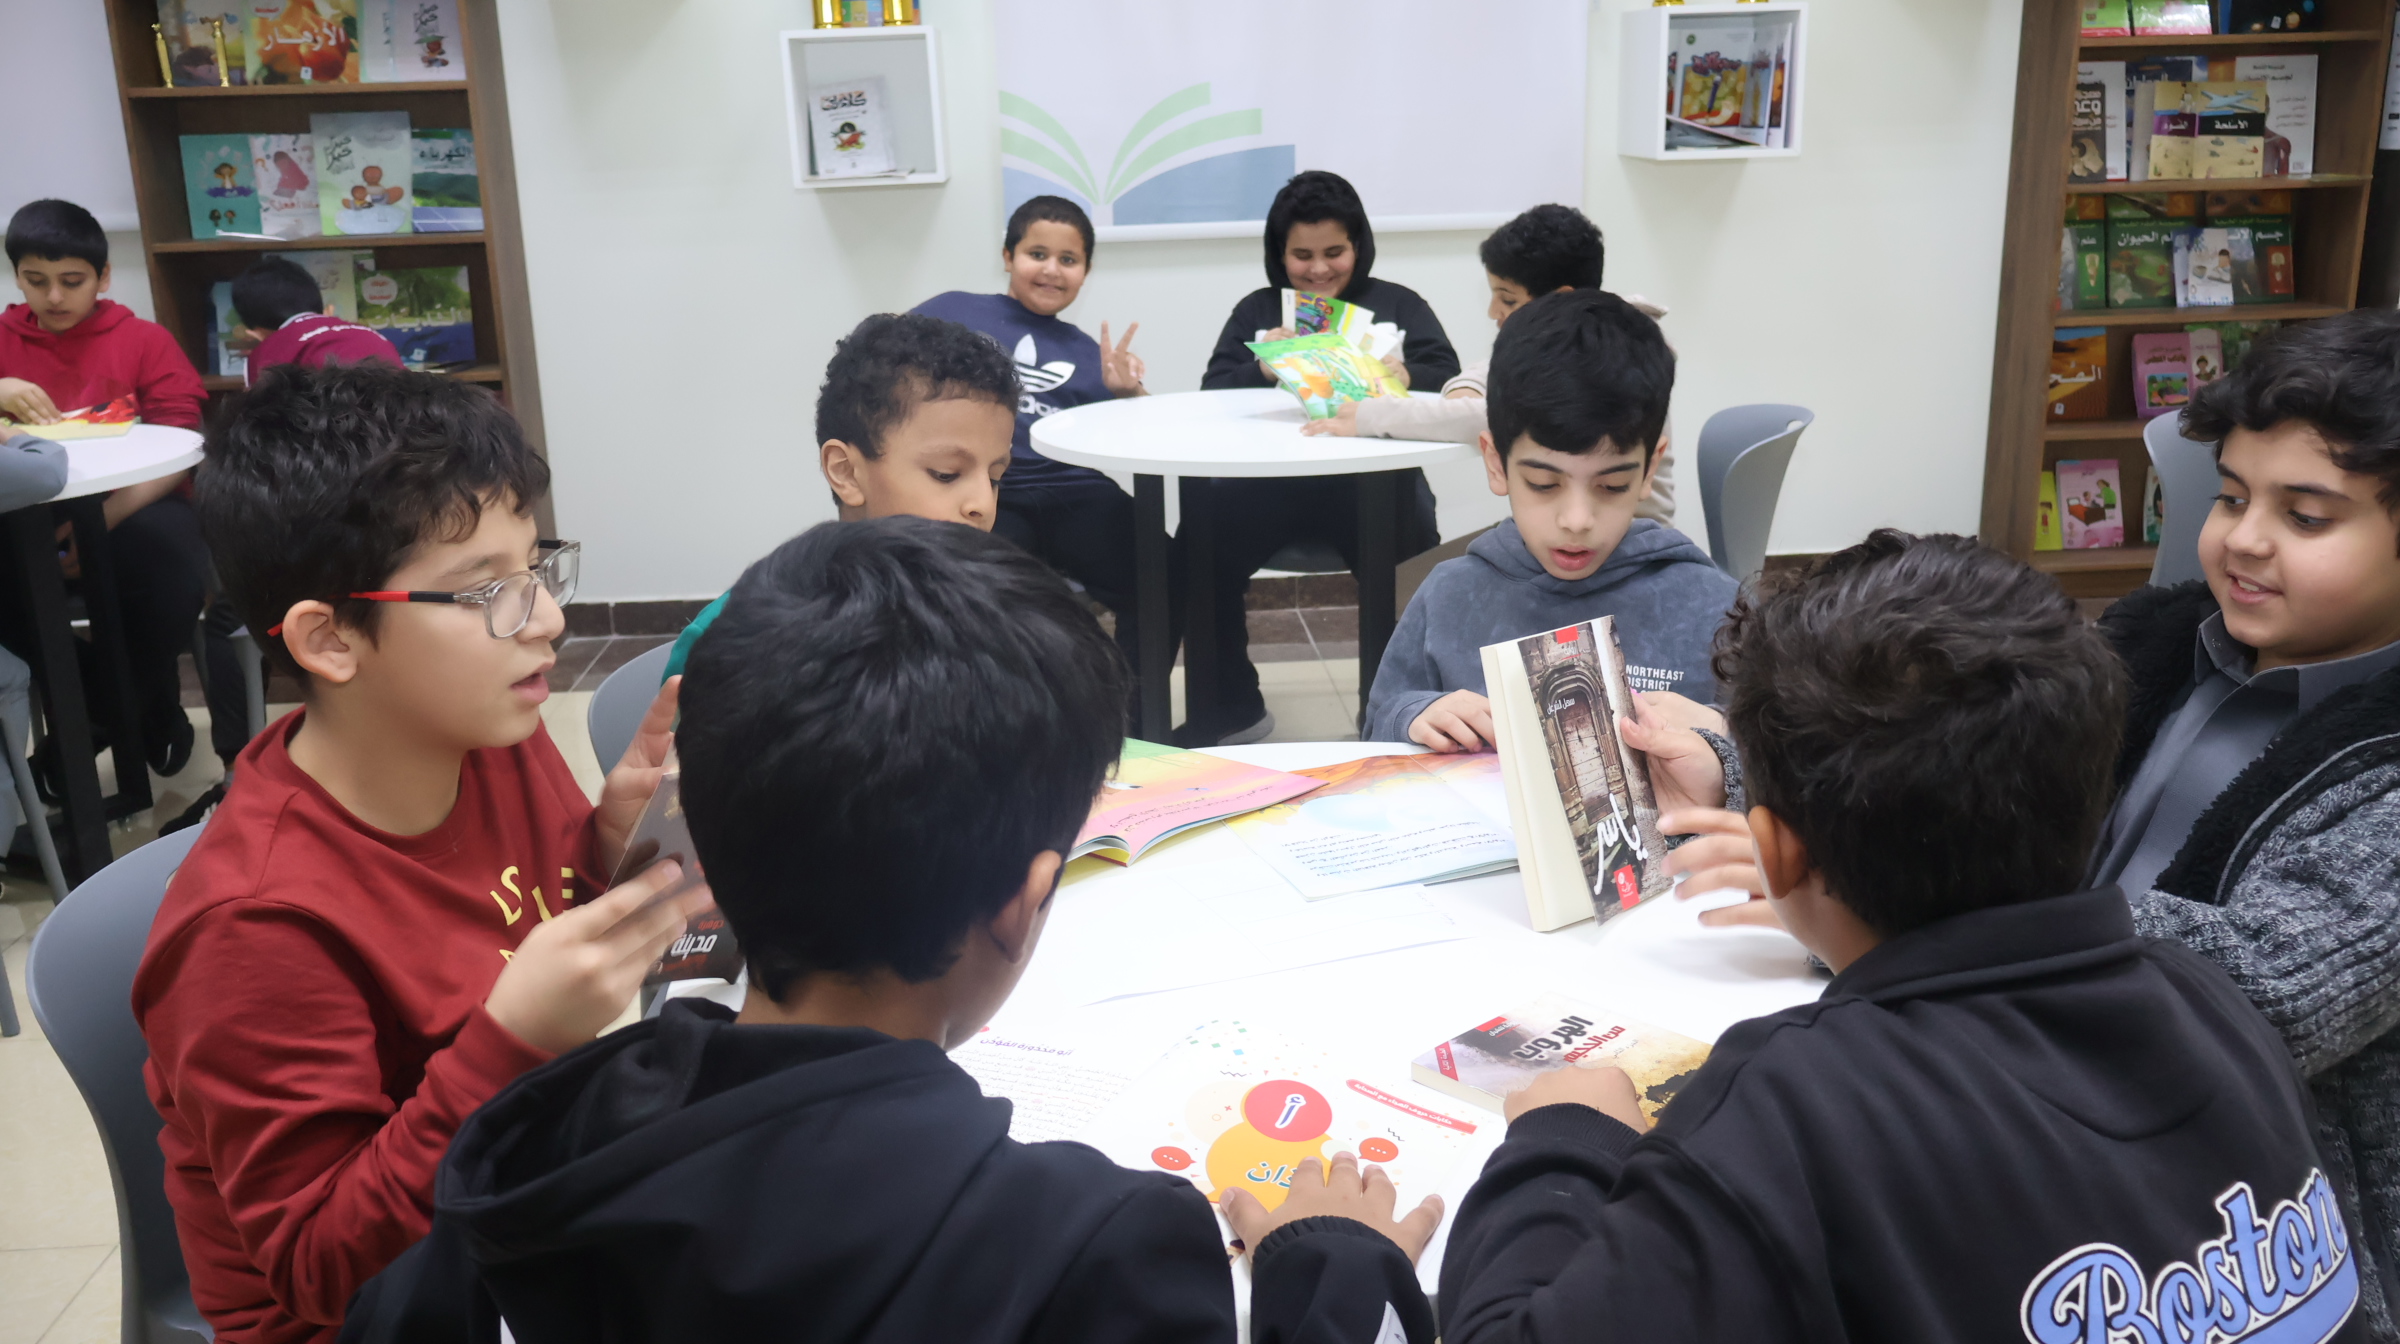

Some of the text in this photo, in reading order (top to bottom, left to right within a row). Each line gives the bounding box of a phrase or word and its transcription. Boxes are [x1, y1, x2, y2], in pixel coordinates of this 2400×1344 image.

[263, 22, 345, 51] الأزهار
[2117, 230, 2159, 247] الحيوان
[1626, 664, 1684, 681] NORTHEAST
[1594, 793, 1649, 895] ياسر
[1511, 1015, 1594, 1062] الهروب
[1605, 1025, 1626, 1041] من
[1353, 1082, 1453, 1126] حكايات حروف الهجاء مع الصحابة
[2022, 1168, 2348, 1344] Boston
